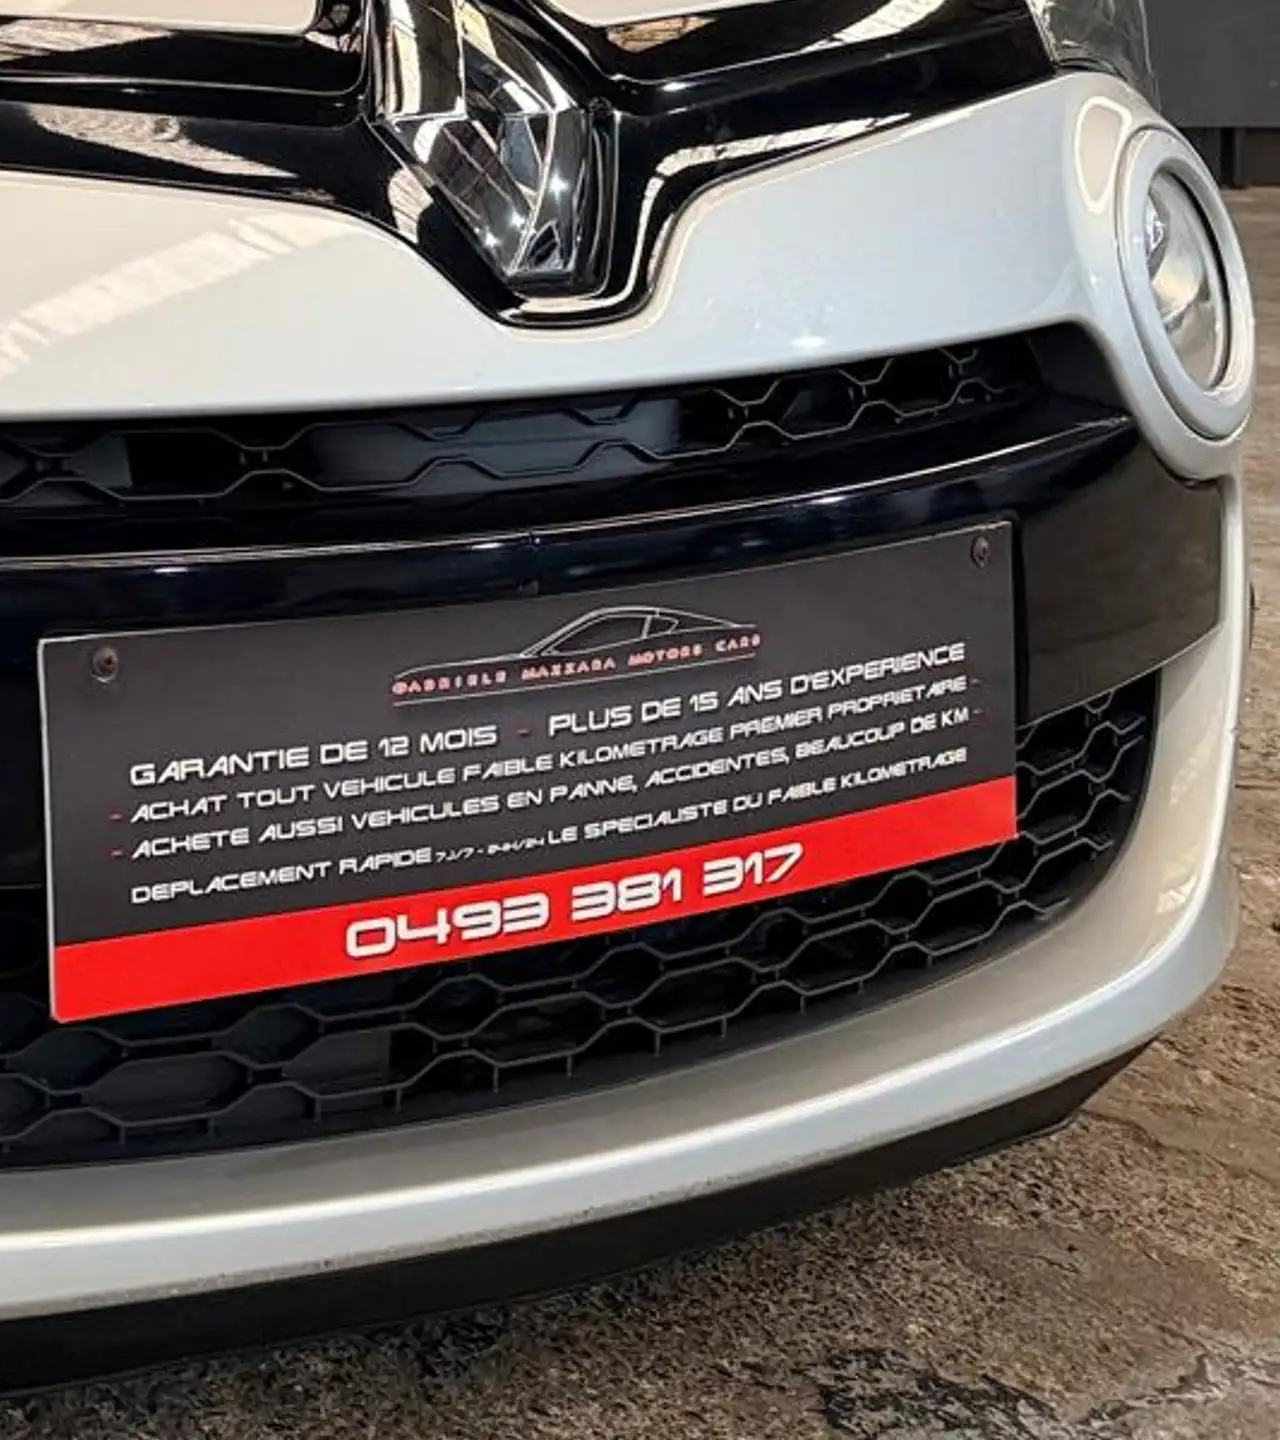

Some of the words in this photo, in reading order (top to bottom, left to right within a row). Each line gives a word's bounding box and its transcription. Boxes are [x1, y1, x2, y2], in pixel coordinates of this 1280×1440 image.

[130, 746, 310, 786] GARANTIE
[319, 739, 369, 765] DE
[378, 734, 409, 758] 12
[420, 725, 498, 753] MOIS
[548, 705, 632, 737] PLUS
[641, 697, 682, 723] DE
[689, 690, 719, 712] 15
[727, 680, 783, 707] ANS
[790, 642, 965, 695] D'EXPERIENCE
[628, 644, 703, 667] MOTORS
[715, 633, 761, 653] CARS
[131, 794, 228, 823] ACHAT
[236, 785, 316, 809] TOUT
[323, 767, 456, 799] VEHICULE
[463, 753, 554, 782] FAIBLE
[559, 726, 724, 768] KILOMETRAGE
[729, 706, 823, 740] PREMIER
[828, 675, 967, 718] PROPRIETAIRE
[132, 827, 249, 859] ACHETE
[258, 816, 343, 843] AUSSI
[351, 795, 499, 830] VEHICULES
[507, 789, 542, 809] EN
[550, 774, 638, 803] PANNE,
[645, 746, 790, 787] ACCIDENTES,
[795, 720, 905, 759] BEAUCOUP
[910, 713, 937, 734] DE
[941, 707, 970, 728] KM
[131, 861, 332, 904] DEPLACEMENT
[339, 847, 432, 875] RAPIDE
[548, 825, 578, 845] LE
[584, 799, 727, 839] SPECIALISTE
[732, 792, 763, 813] DU
[768, 776, 837, 806] FAIBLE
[840, 747, 968, 789] KILOMETRAGE
[345, 891, 550, 959] 0493
[571, 868, 682, 922] 381
[703, 843, 803, 897] 317
